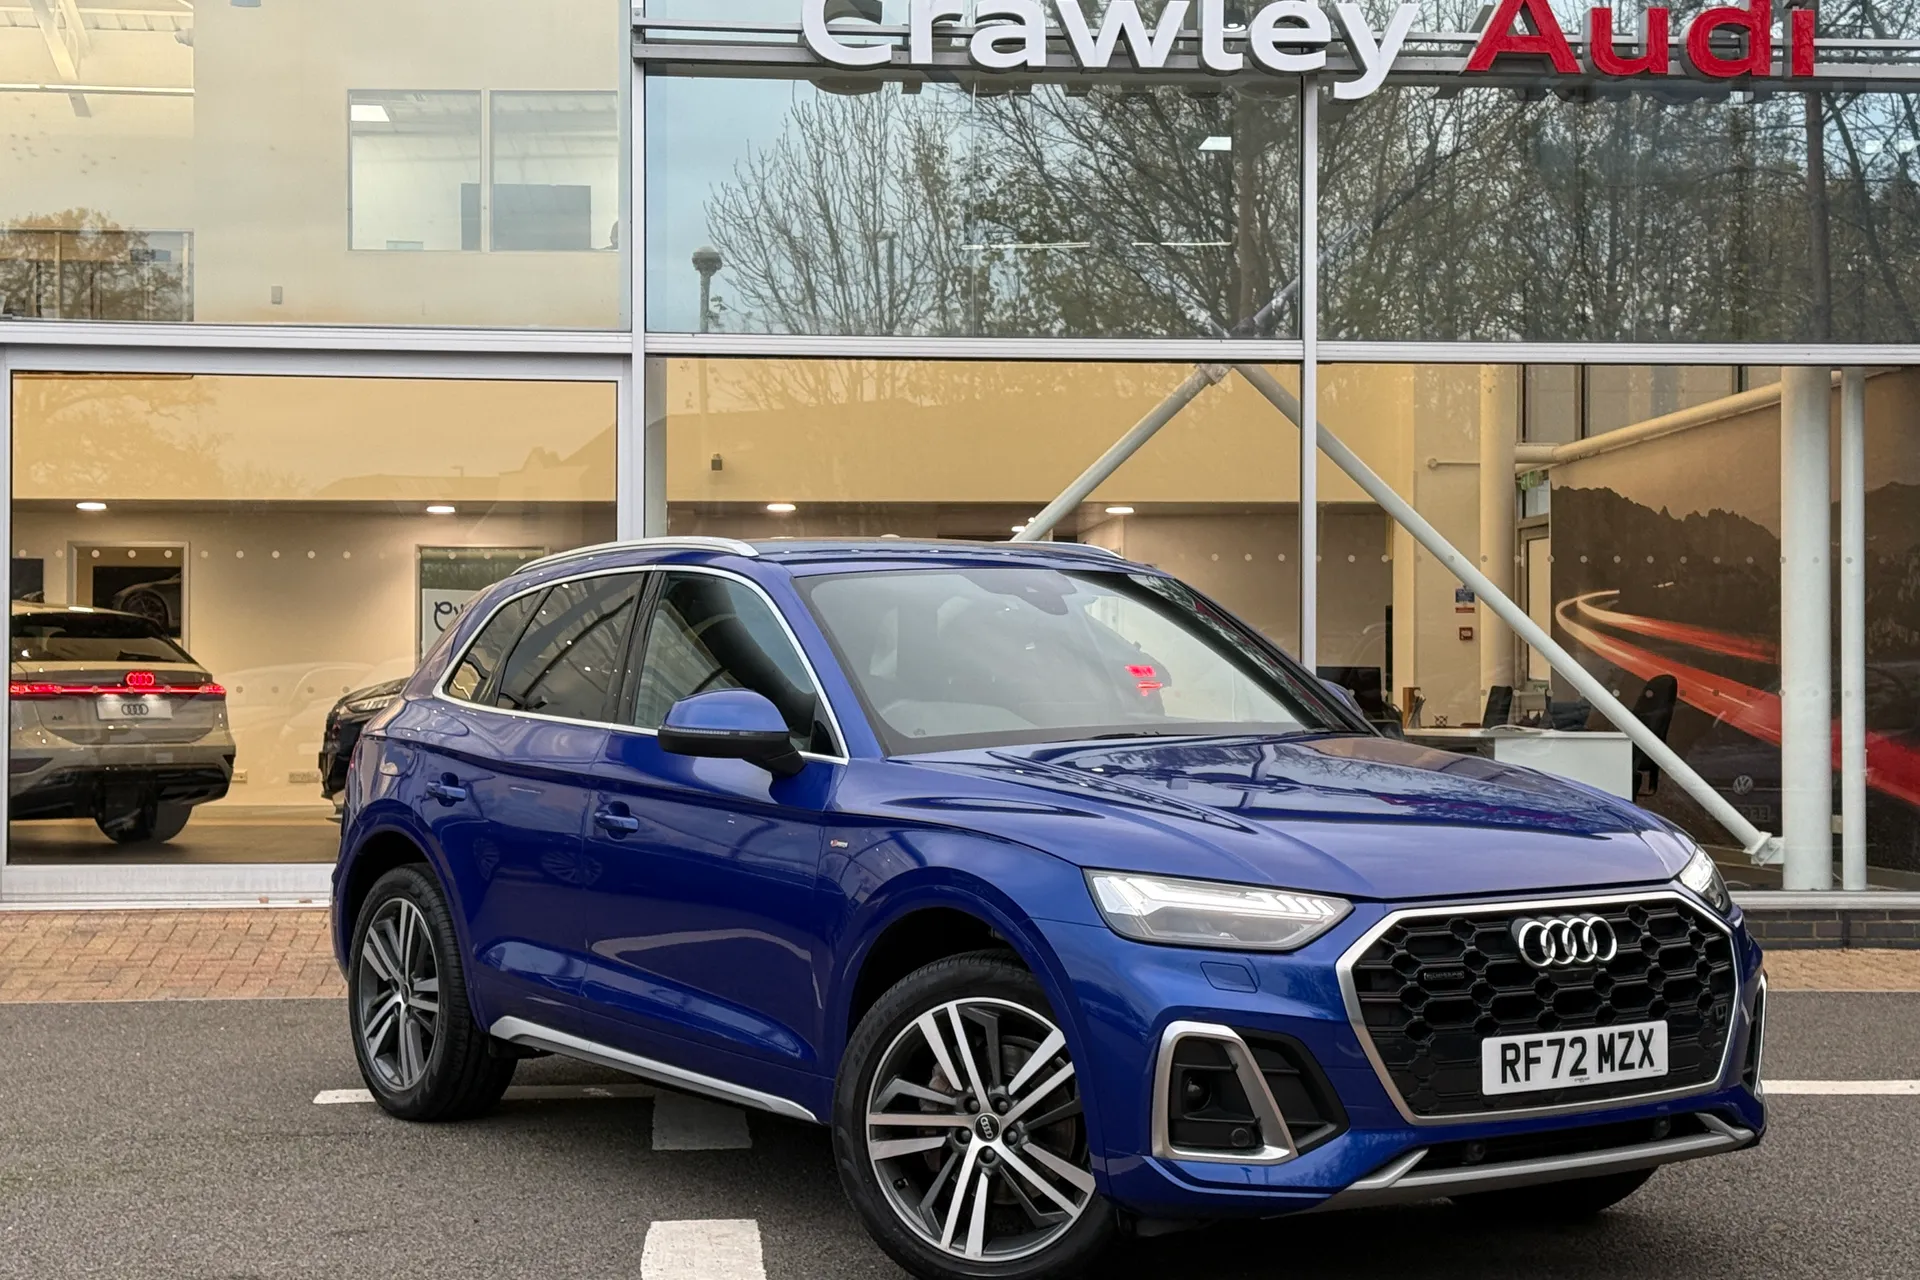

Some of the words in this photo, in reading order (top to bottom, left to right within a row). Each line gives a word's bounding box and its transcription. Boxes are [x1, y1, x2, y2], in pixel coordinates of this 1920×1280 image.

[802, 0, 1420, 100] Crawley
[1466, 0, 1815, 77] Audi
[1501, 1036, 1588, 1084] RF72
[1597, 1028, 1655, 1074] MZX
